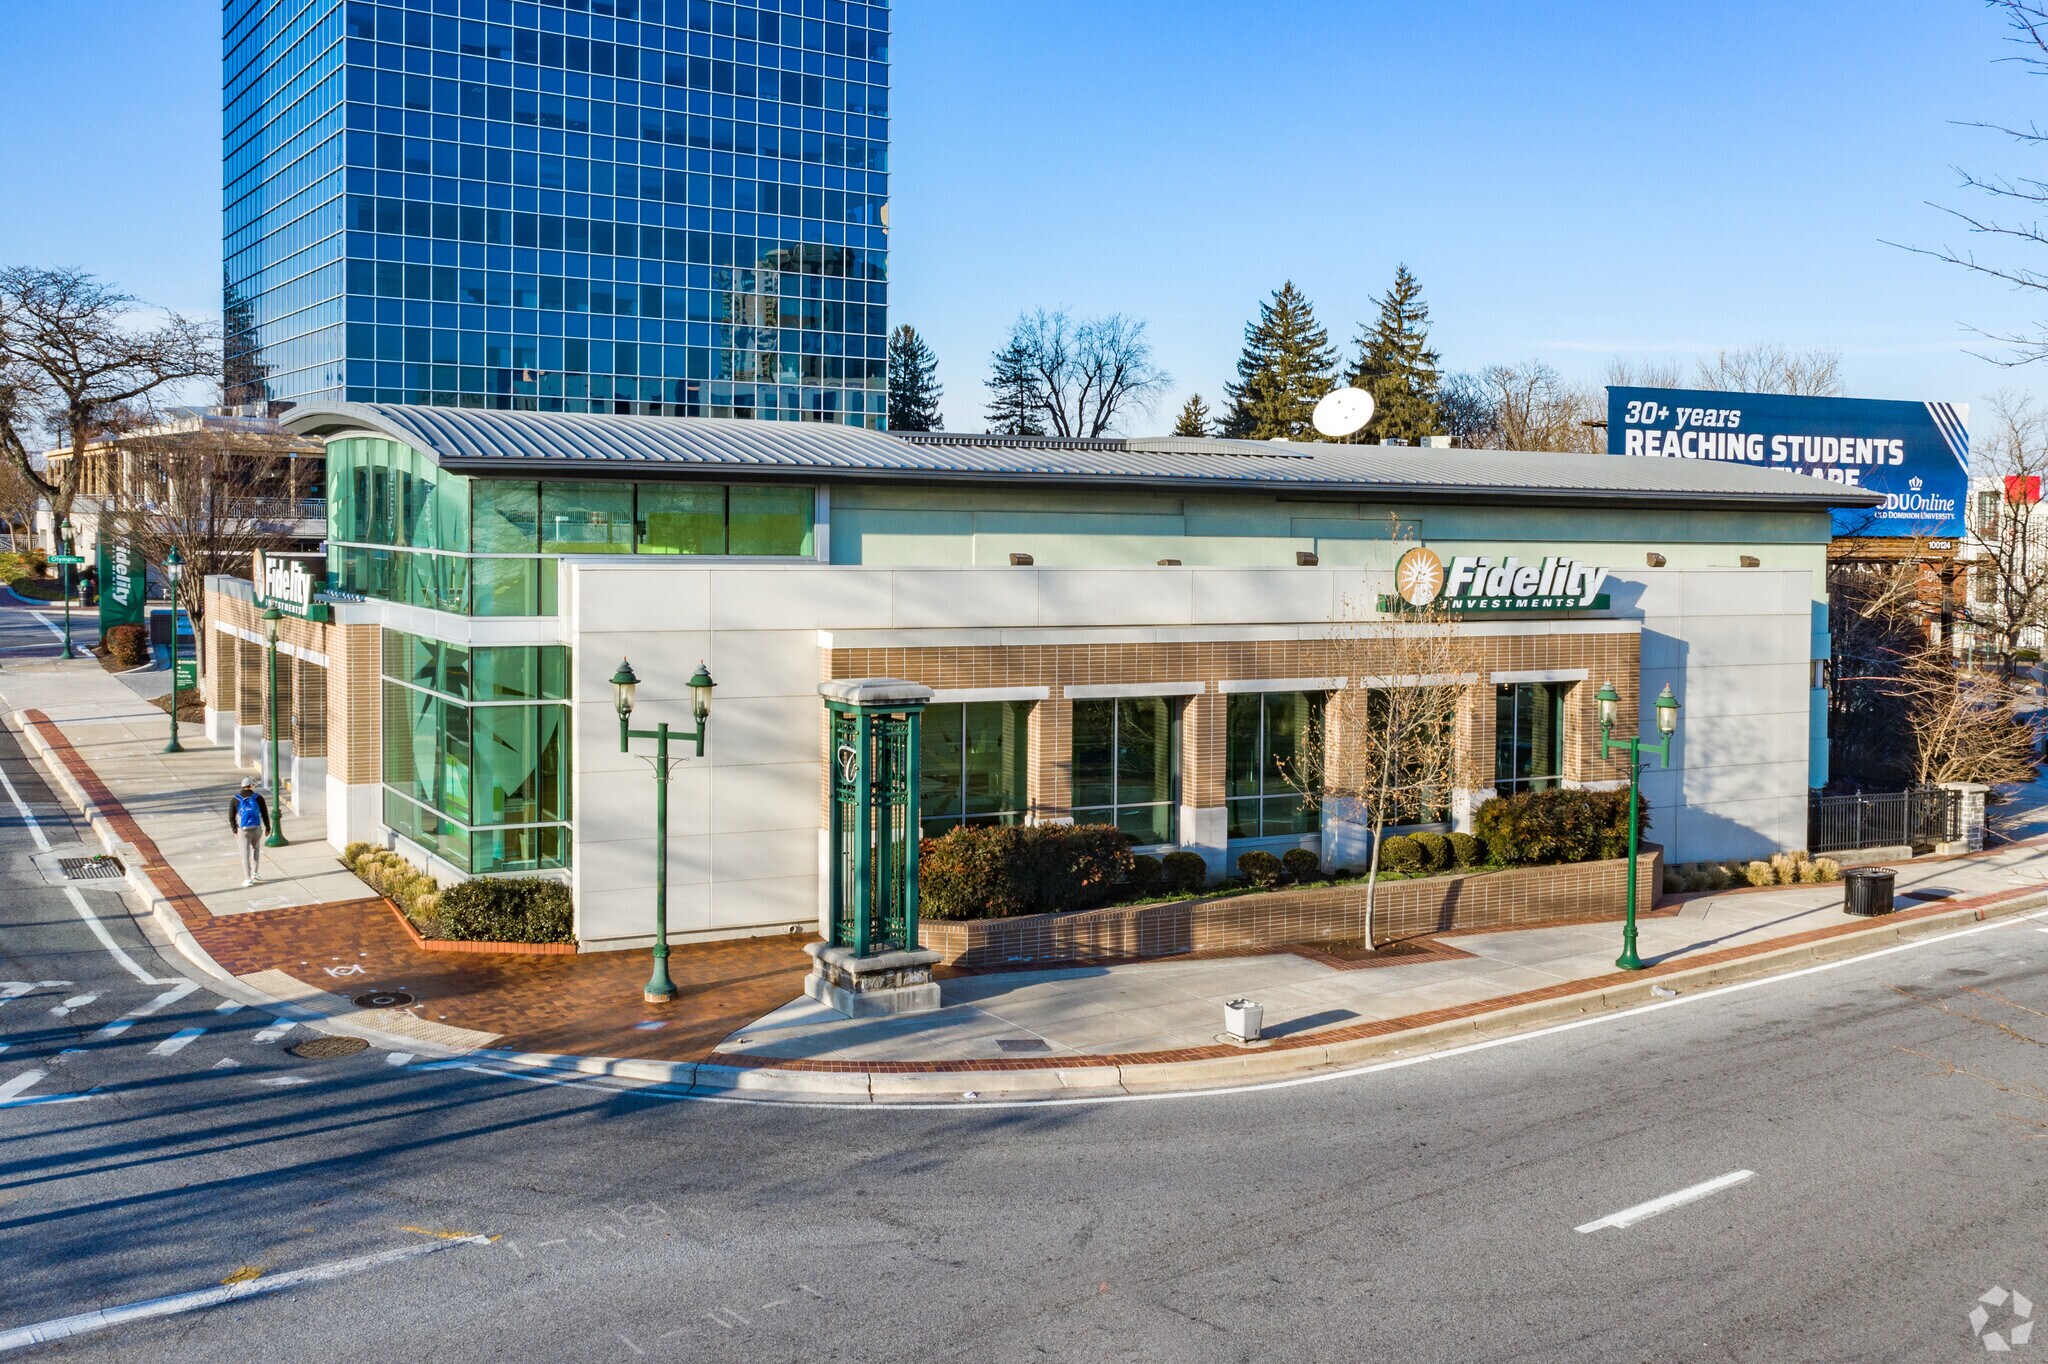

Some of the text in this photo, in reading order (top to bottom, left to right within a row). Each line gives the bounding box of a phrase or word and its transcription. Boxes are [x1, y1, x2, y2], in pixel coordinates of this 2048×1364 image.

[1625, 400, 1741, 430] 30+ years
[1625, 428, 1904, 466] REACHING STUDENTS
[1888, 511, 1920, 519] DOMINION
[1928, 541, 1951, 549] 100124
[265, 557, 311, 616] Fidelity
[1444, 556, 1609, 607] Fidelity
